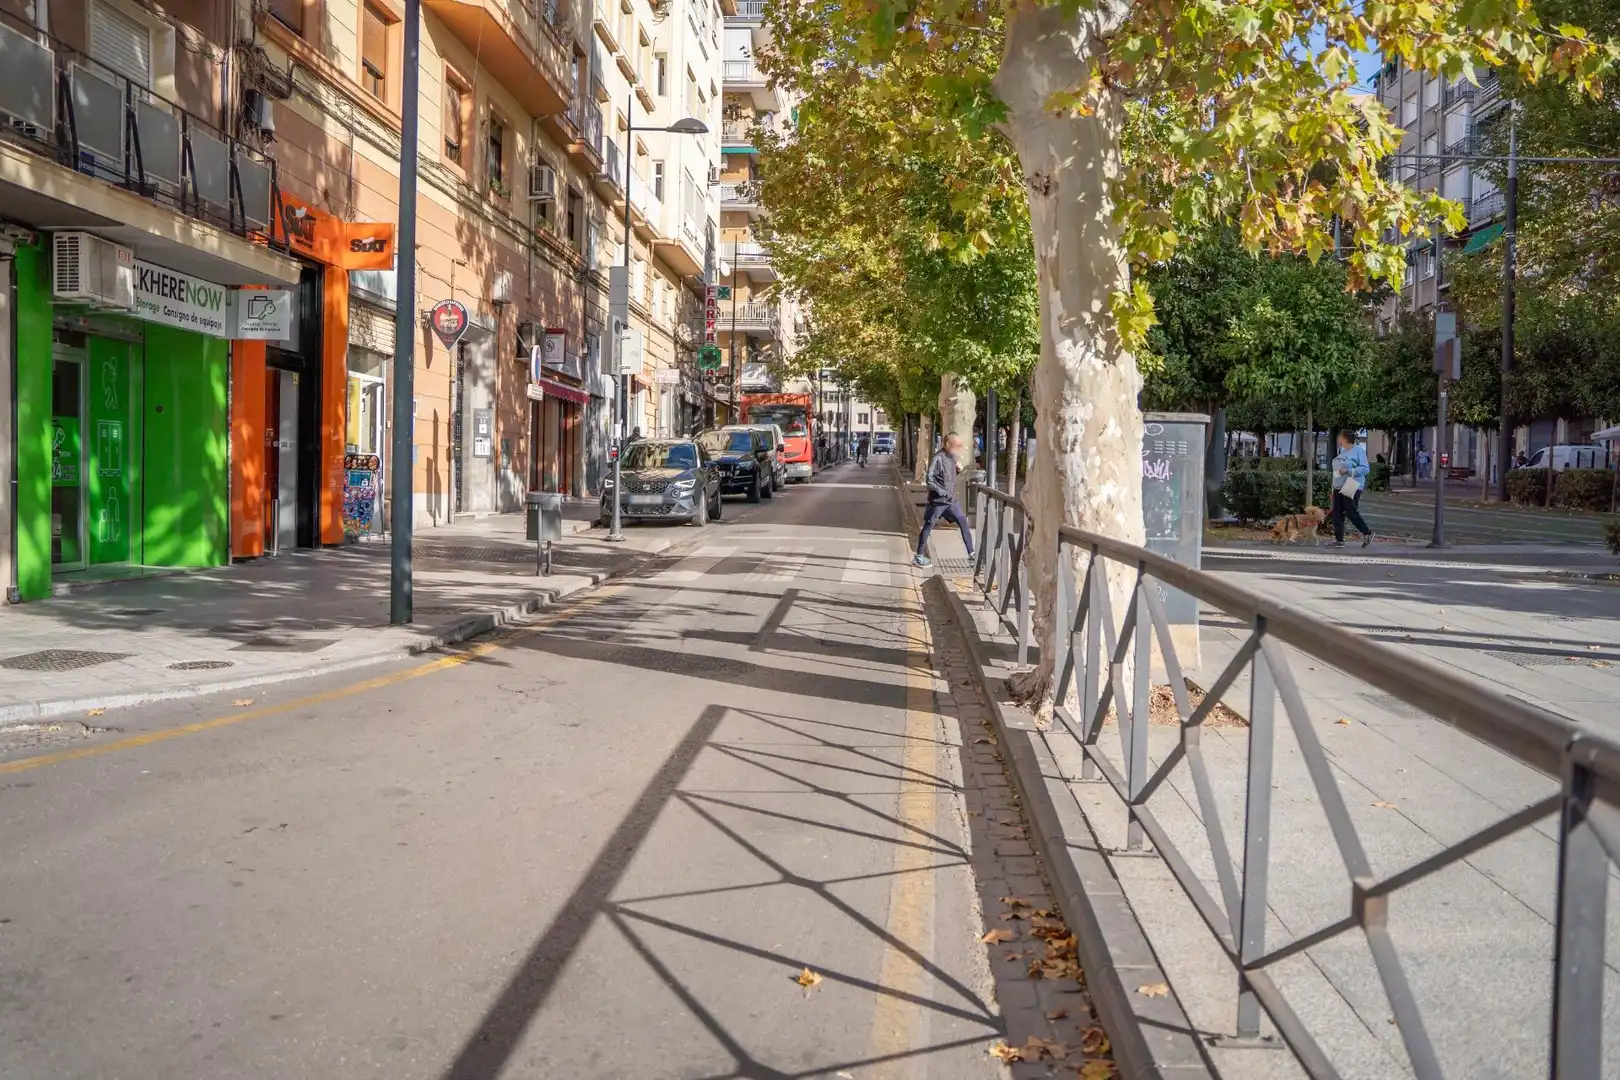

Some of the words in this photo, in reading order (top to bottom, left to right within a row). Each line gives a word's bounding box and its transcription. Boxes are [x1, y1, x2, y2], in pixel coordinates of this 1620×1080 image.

[163, 305, 189, 322] Consigna
[191, 312, 198, 323] de
[200, 317, 222, 331] equipaje
